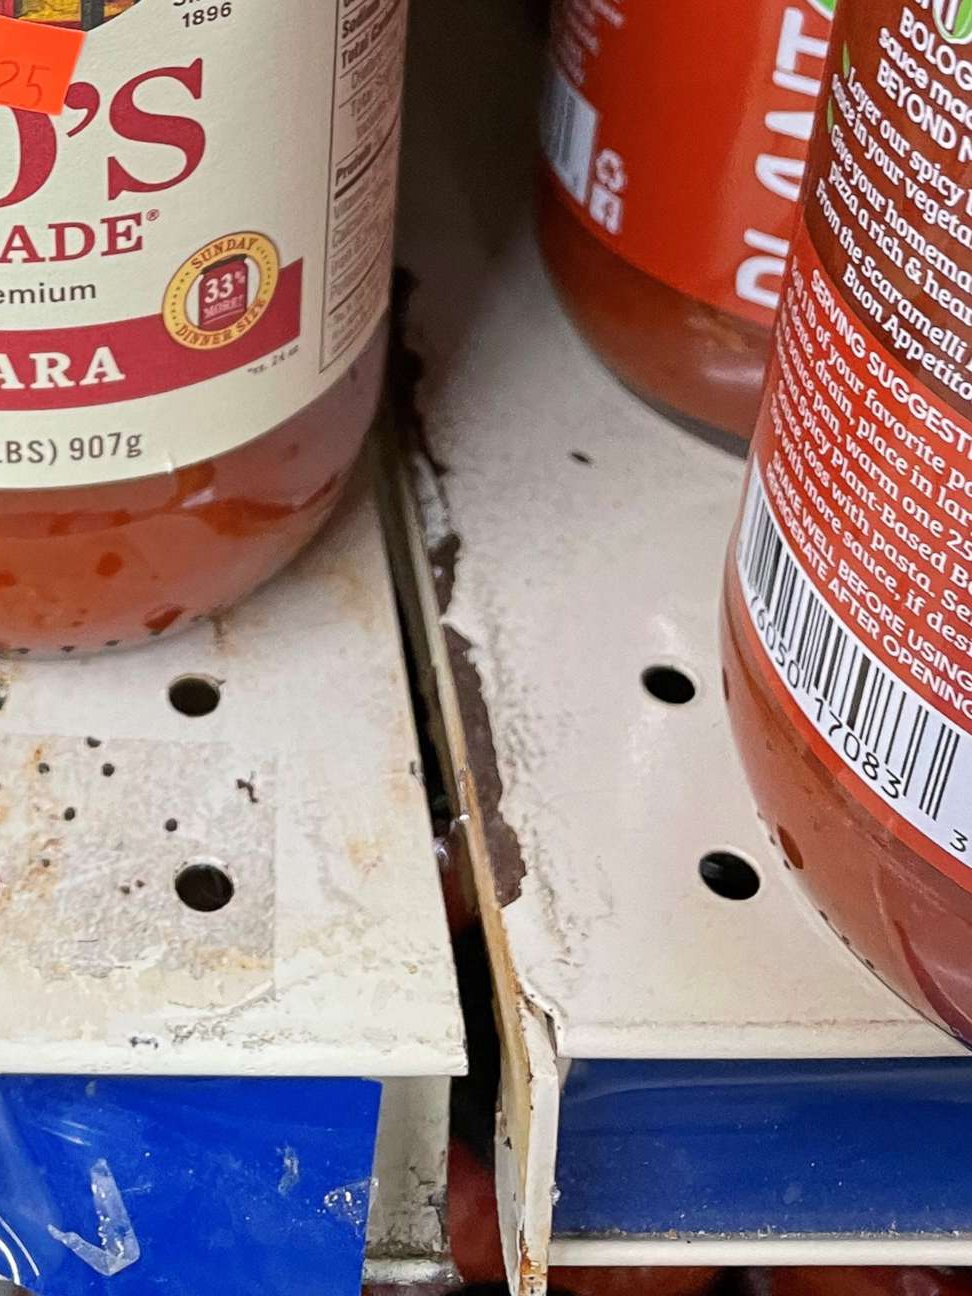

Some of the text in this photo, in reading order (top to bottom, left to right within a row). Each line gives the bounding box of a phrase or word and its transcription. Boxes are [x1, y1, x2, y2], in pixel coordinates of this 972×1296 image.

[181, 1, 234, 29] 1896
[879, 27, 928, 90] sauce
[848, 66, 881, 126] Layer
[880, 119, 911, 158] our
[909, 150, 965, 207] spicy
[853, 113, 867, 147] in
[864, 135, 904, 186] your
[877, 57, 958, 150] BEYOND
[850, 162, 886, 212] your
[191, 238, 260, 271] SUNDAY
[858, 208, 869, 231] a
[868, 220, 904, 269] rich
[904, 256, 924, 285] &
[175, 298, 267, 346] DINNER SIZE
[811, 268, 867, 360] SERVING
[839, 225, 862, 265] the
[861, 255, 968, 364] Scaramelli
[842, 262, 884, 324] Buon
[69, 432, 143, 459] 907g
[816, 324, 831, 352] of
[827, 344, 865, 396] your
[864, 387, 946, 476] favorite
[816, 359, 855, 426] drain,
[856, 415, 909, 477] place
[910, 464, 934, 499] in
[813, 390, 842, 443] pan,
[845, 433, 900, 502] warm
[902, 496, 944, 539] one
[782, 430, 805, 483] with
[804, 475, 843, 536] more
[842, 530, 902, 602] sauce,
[904, 589, 927, 617] if
[803, 440, 831, 489] toss
[831, 481, 870, 537] with
[870, 528, 936, 599] pasta.
[802, 506, 837, 568] WELL
[837, 558, 906, 638] BEFORE
[907, 628, 972, 692] USING
[828, 577, 880, 641] AFTER
[882, 634, 972, 720] OPENING
